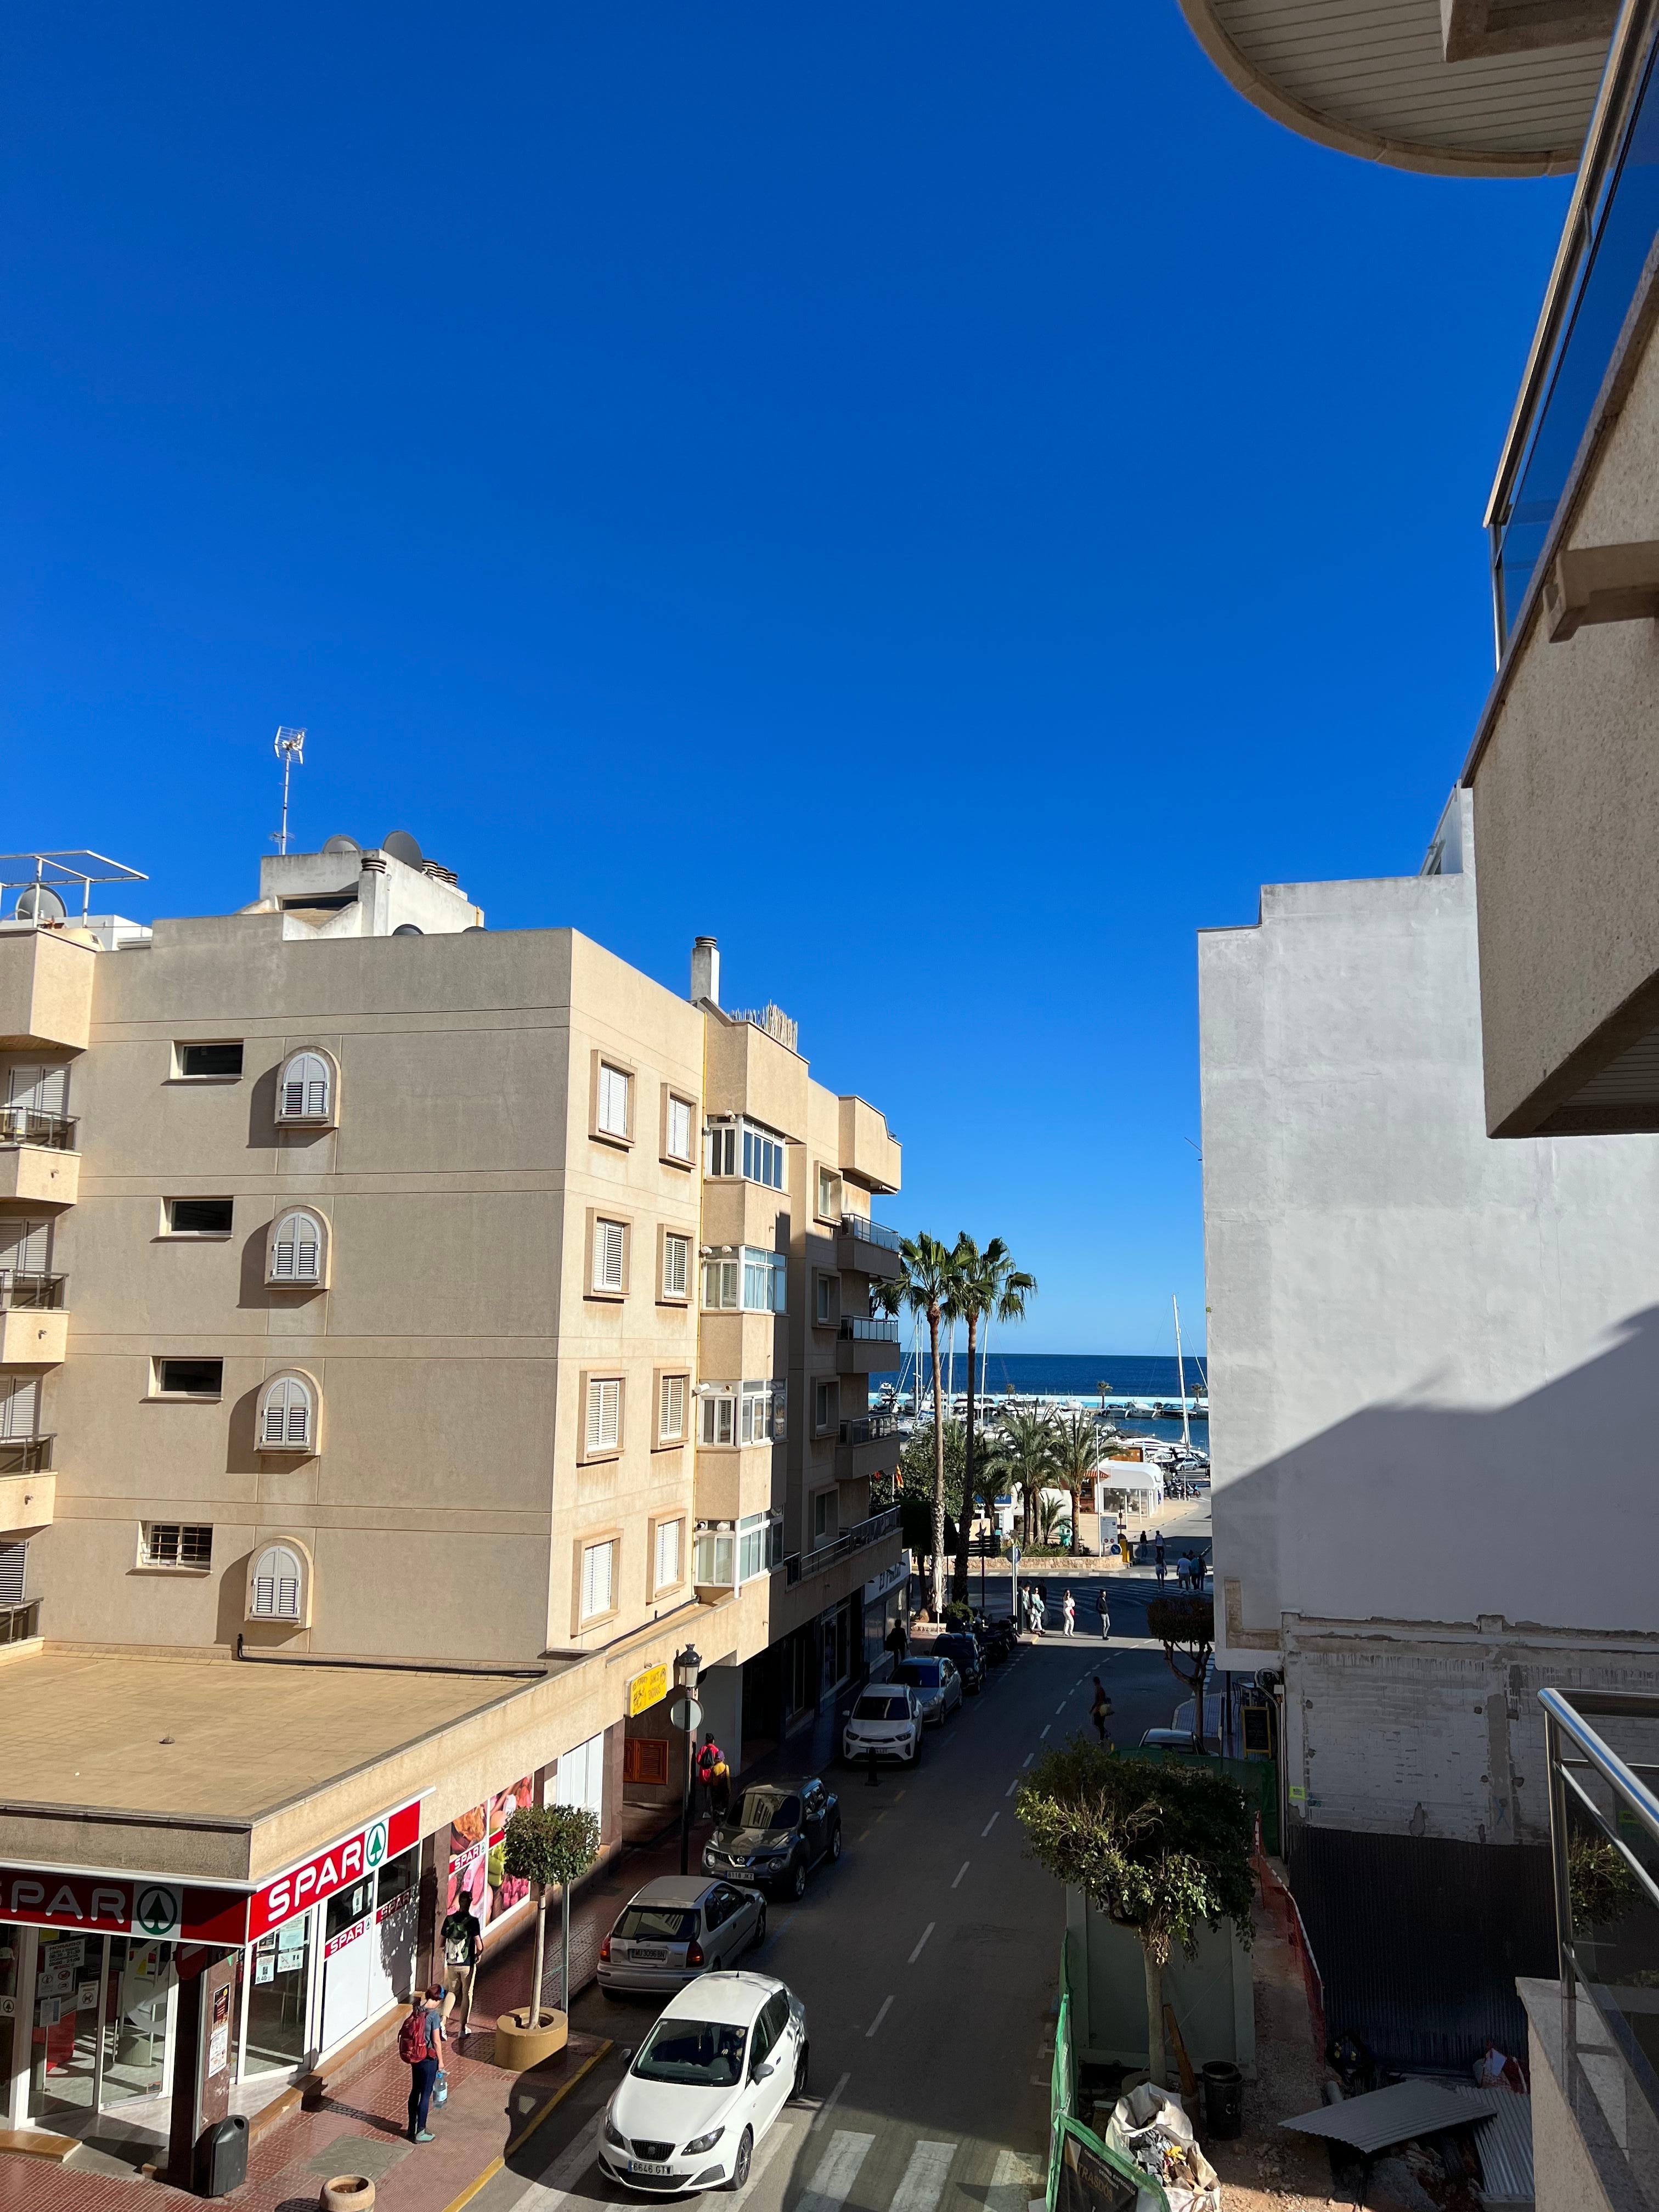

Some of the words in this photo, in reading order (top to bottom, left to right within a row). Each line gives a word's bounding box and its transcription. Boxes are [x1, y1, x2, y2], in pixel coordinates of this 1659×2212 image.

[454, 1846, 479, 1870] SPAR
[268, 1841, 362, 1922] SPAR
[0, 1880, 126, 1924] PAR
[381, 1892, 409, 1919] SPAR
[330, 1922, 363, 1954] SPAR
[1077, 2163, 1113, 2202] TRASDÓS
